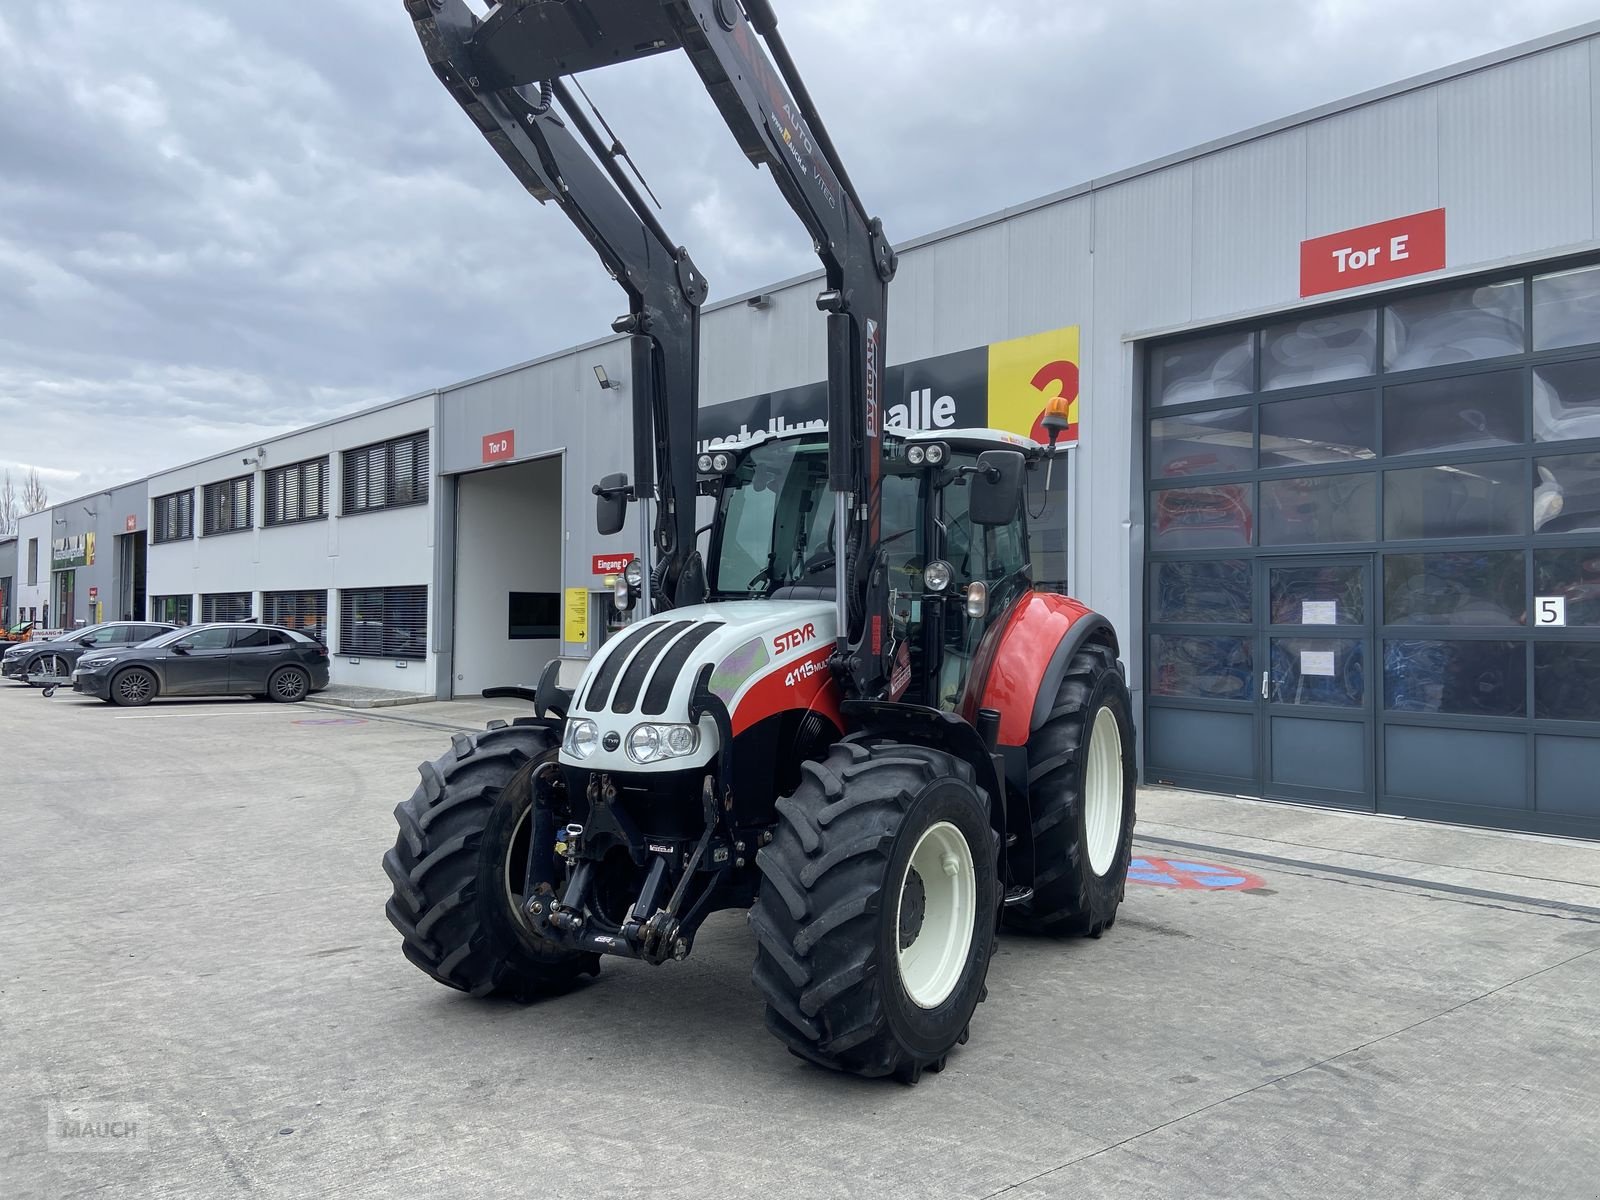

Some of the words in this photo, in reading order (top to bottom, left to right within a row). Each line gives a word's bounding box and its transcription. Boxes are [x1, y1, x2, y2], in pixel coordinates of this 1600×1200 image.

[782, 103, 813, 154] AUTO
[813, 166, 836, 209] VITEC
[1333, 246, 1380, 273] Tor
[1390, 234, 1409, 262] E
[489, 442, 500, 454] Tor
[501, 439, 507, 452] D
[597, 559, 621, 570] Eingang
[622, 558, 628, 568] D
[1541, 600, 1558, 623] 5
[773, 622, 816, 655] STEYR
[785, 660, 814, 687] 4115
